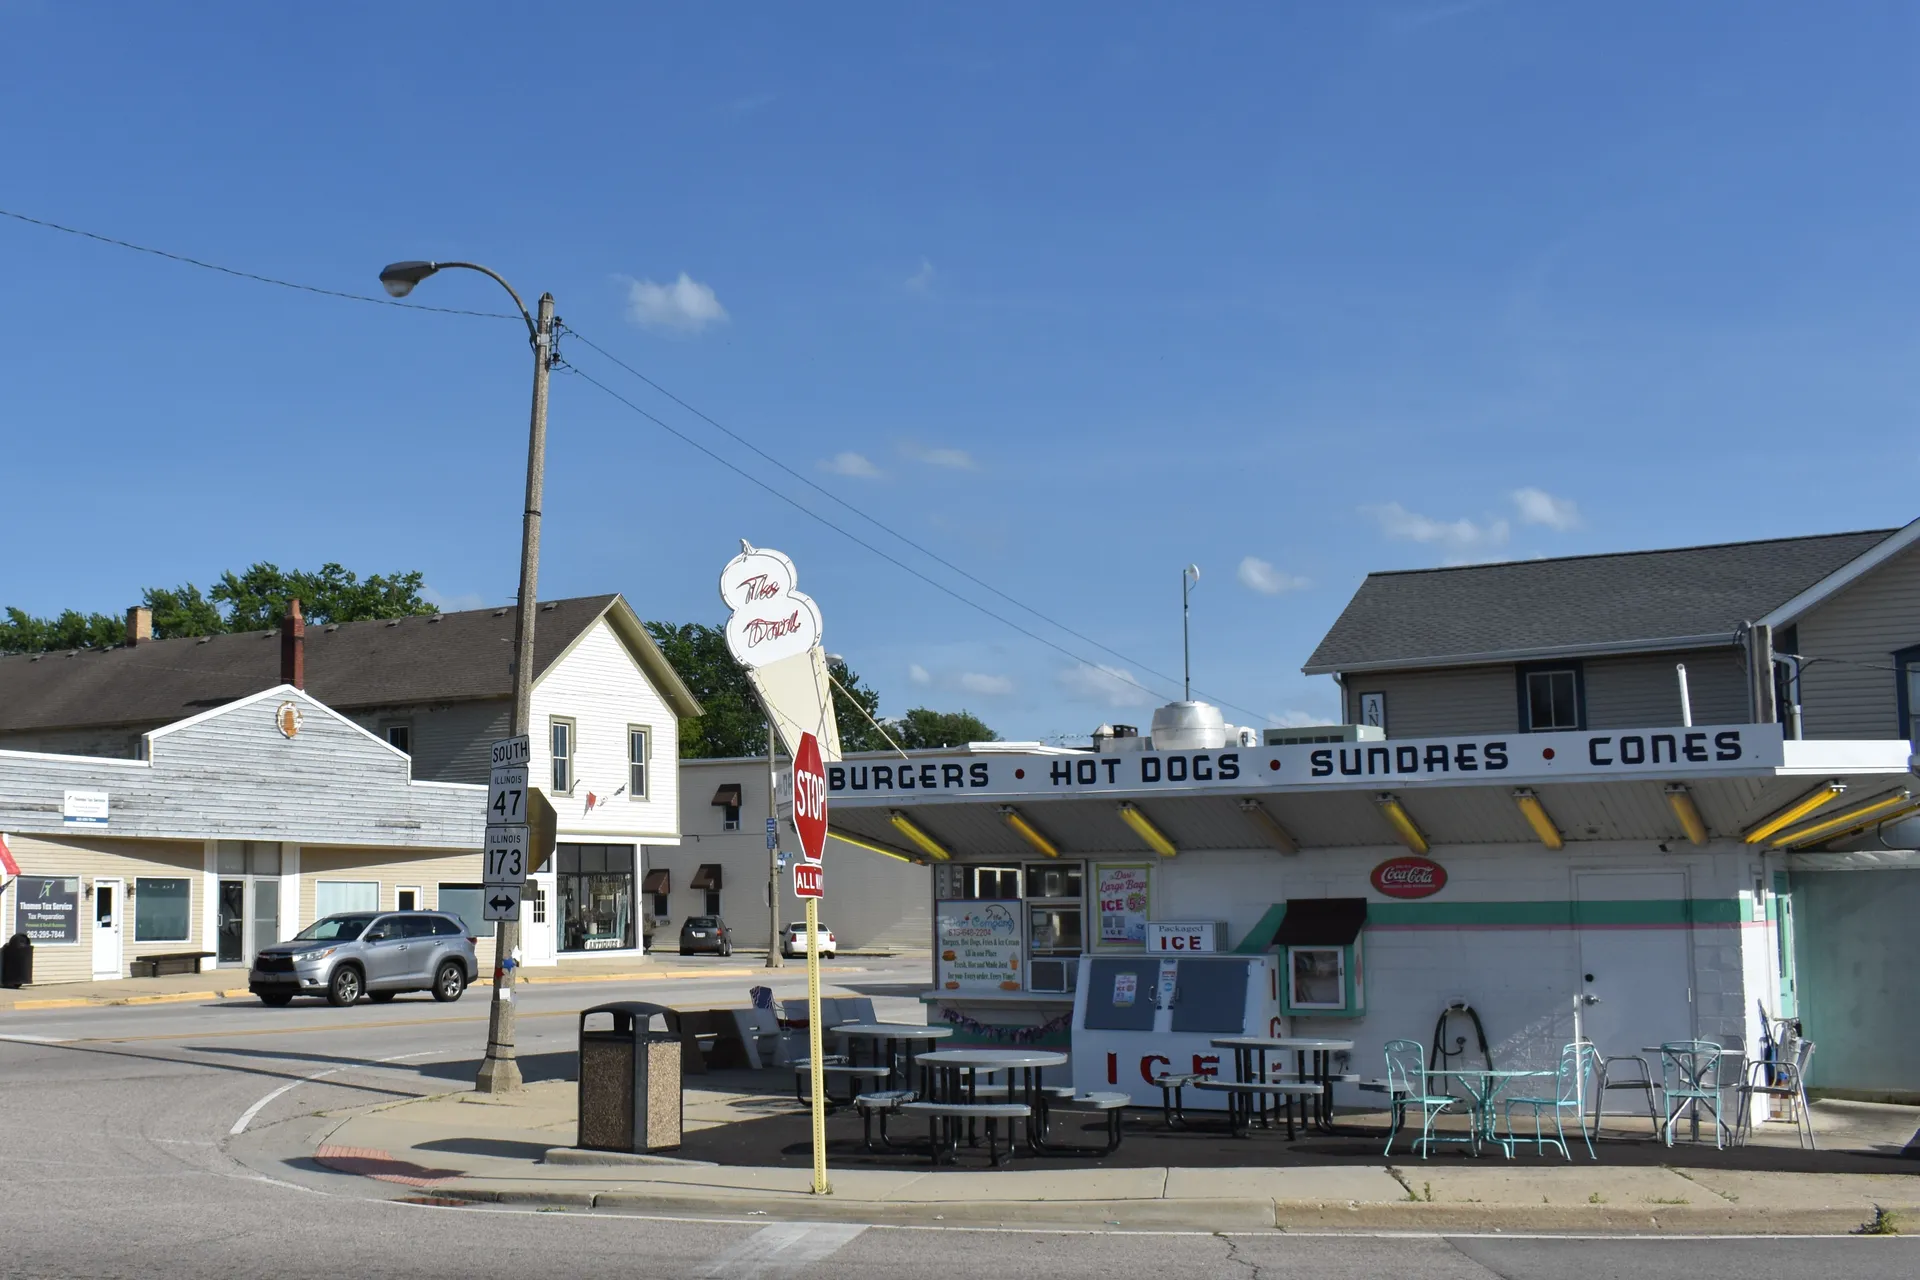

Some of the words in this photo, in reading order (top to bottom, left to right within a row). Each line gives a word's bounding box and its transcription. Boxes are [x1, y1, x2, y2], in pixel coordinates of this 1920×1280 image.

[492, 740, 528, 763] SOUTH
[828, 762, 989, 791] BURGERS
[1050, 758, 1121, 785] HOT
[1141, 753, 1240, 783] DOGS
[1310, 742, 1509, 777] SUNDAES
[1588, 731, 1742, 765] CONES
[494, 775, 522, 785] ILLINOIS
[796, 769, 825, 821] STOP
[493, 790, 522, 816] 47
[490, 834, 521, 844] ILLINOIS
[489, 849, 522, 875] 173
[796, 872, 815, 889] ALL
[1381, 866, 1434, 884] Coca-Cola
[1100, 881, 1125, 893] Large
[42, 902, 52, 911] Tax
[53, 902, 73, 911] Service
[1101, 899, 1124, 912] ICE
[37, 913, 65, 921] Preparation
[971, 915, 1013, 931] Company
[1159, 925, 1204, 933] Packaged
[588, 940, 618, 949] ANTIQUES
[1160, 935, 1202, 950] ICE
[984, 949, 997, 957] Place
[1107, 1050, 1220, 1088] ICE
